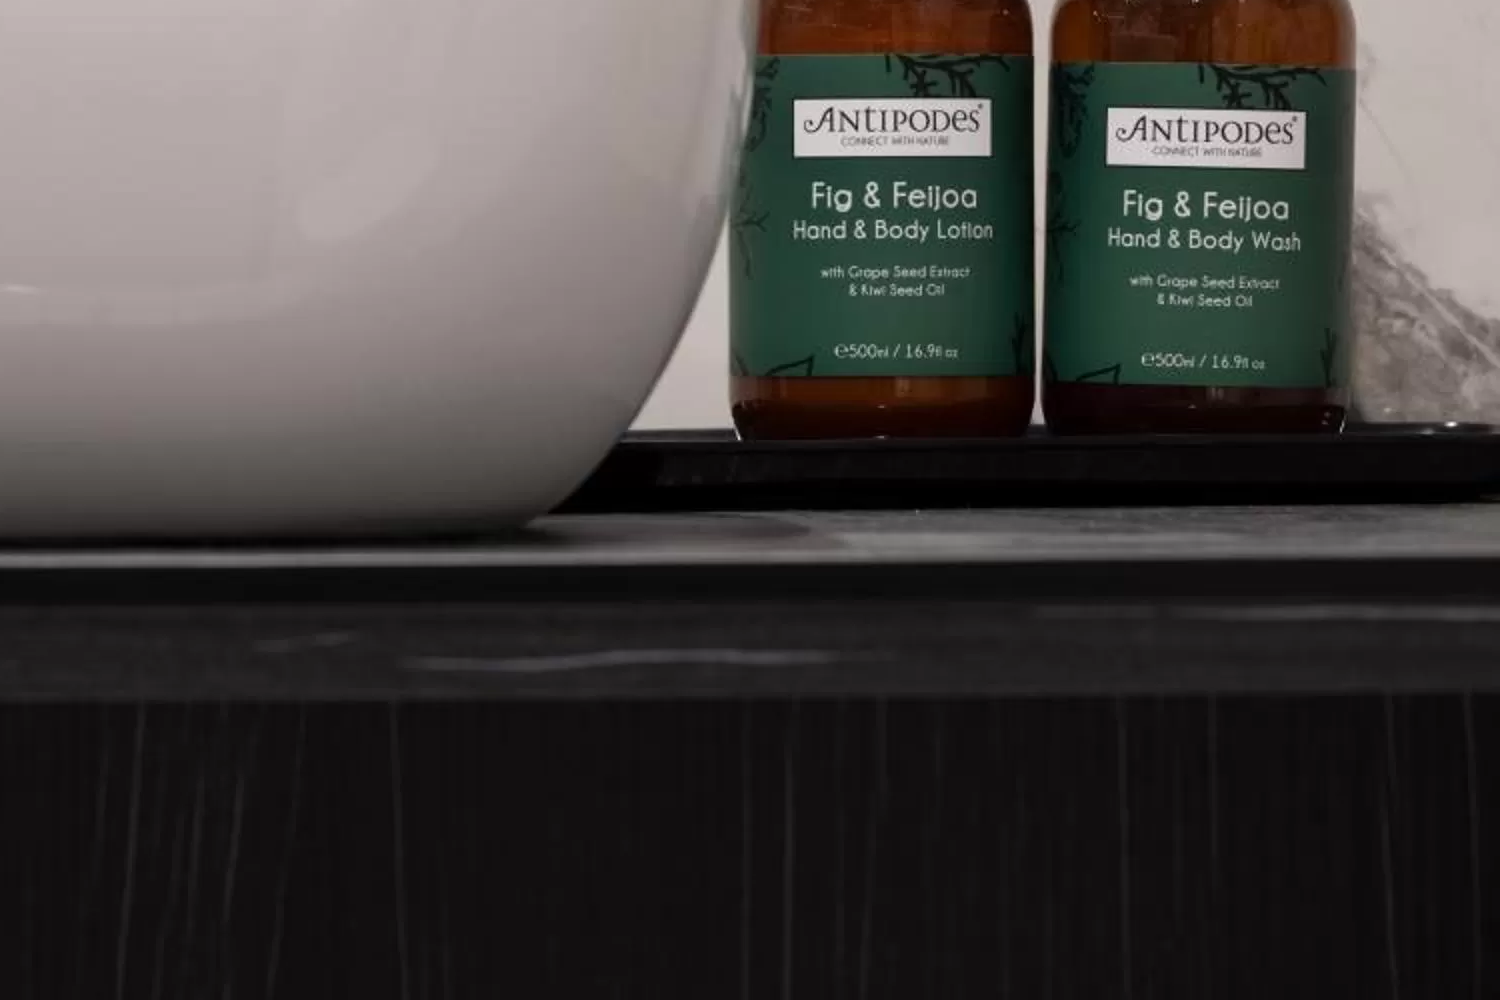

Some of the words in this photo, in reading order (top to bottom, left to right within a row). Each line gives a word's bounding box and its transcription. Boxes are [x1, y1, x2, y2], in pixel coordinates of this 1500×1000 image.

[840, 136, 888, 147] CONNECT
[811, 181, 852, 213] Fig
[863, 181, 881, 209] &
[893, 181, 978, 211] Feijoa
[1122, 189, 1163, 221] Fig
[1174, 190, 1191, 218] &
[1203, 191, 1289, 222] Feijoa
[793, 220, 847, 240] Hand
[853, 219, 867, 240] &
[875, 219, 929, 243] Body
[937, 219, 993, 240] Lotion
[1107, 228, 1160, 248] Hand
[1167, 229, 1181, 249] &
[1189, 229, 1244, 254] Body
[1252, 231, 1301, 251] Wash
[820, 266, 845, 278] with
[848, 265, 889, 280] Grape
[893, 265, 927, 278] Seed
[929, 265, 971, 278] Extract
[1130, 275, 1153, 287] with
[1157, 274, 1198, 290] Grape
[1202, 275, 1235, 289] Seed
[1239, 276, 1280, 289] Extract
[849, 283, 858, 297] &
[861, 283, 887, 297] Kiwi
[889, 283, 923, 297] Seed
[926, 283, 945, 297] Oil
[1169, 293, 1194, 306] Kiwi
[1198, 294, 1231, 307] Seed
[1235, 294, 1253, 307] Oil
[893, 343, 901, 358] /
[1199, 353, 1207, 368] /
